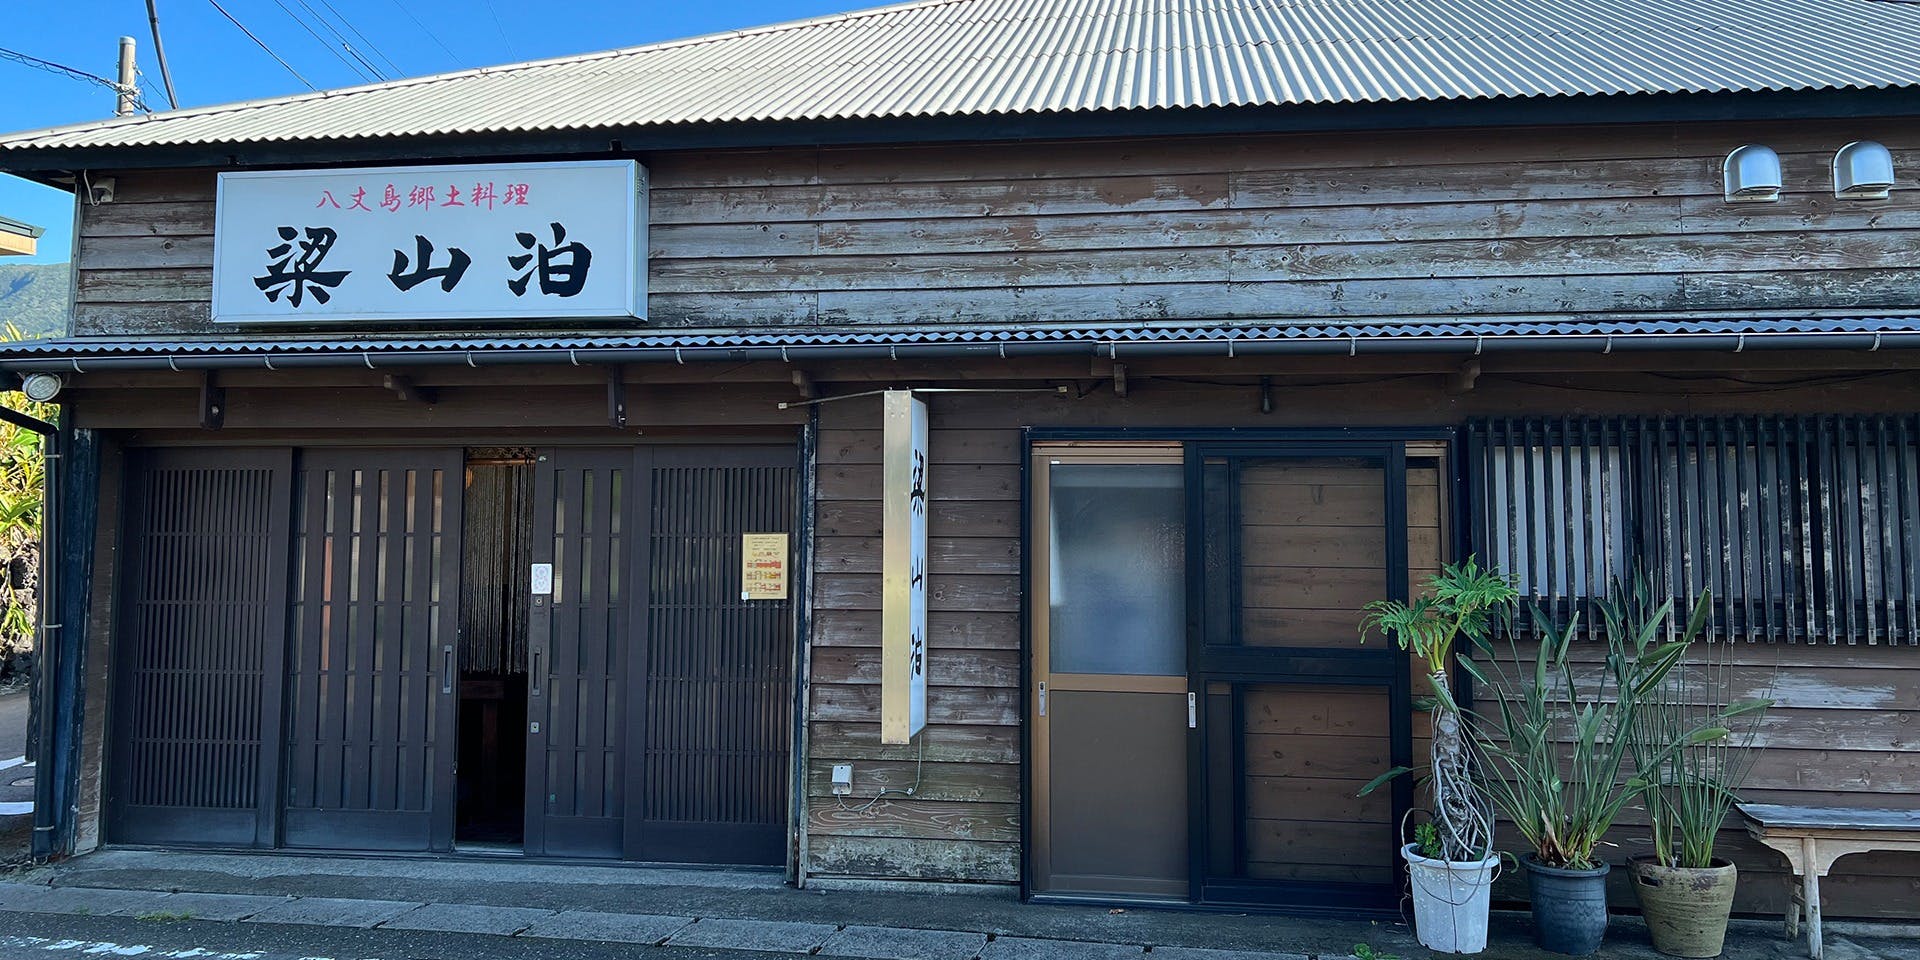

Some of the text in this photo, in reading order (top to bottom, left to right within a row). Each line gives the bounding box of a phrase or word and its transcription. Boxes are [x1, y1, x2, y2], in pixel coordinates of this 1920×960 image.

[316, 183, 530, 212] 八丈島郷土料理
[253, 222, 592, 308] 梁山泊
[910, 448, 925, 680] 梁山泊
